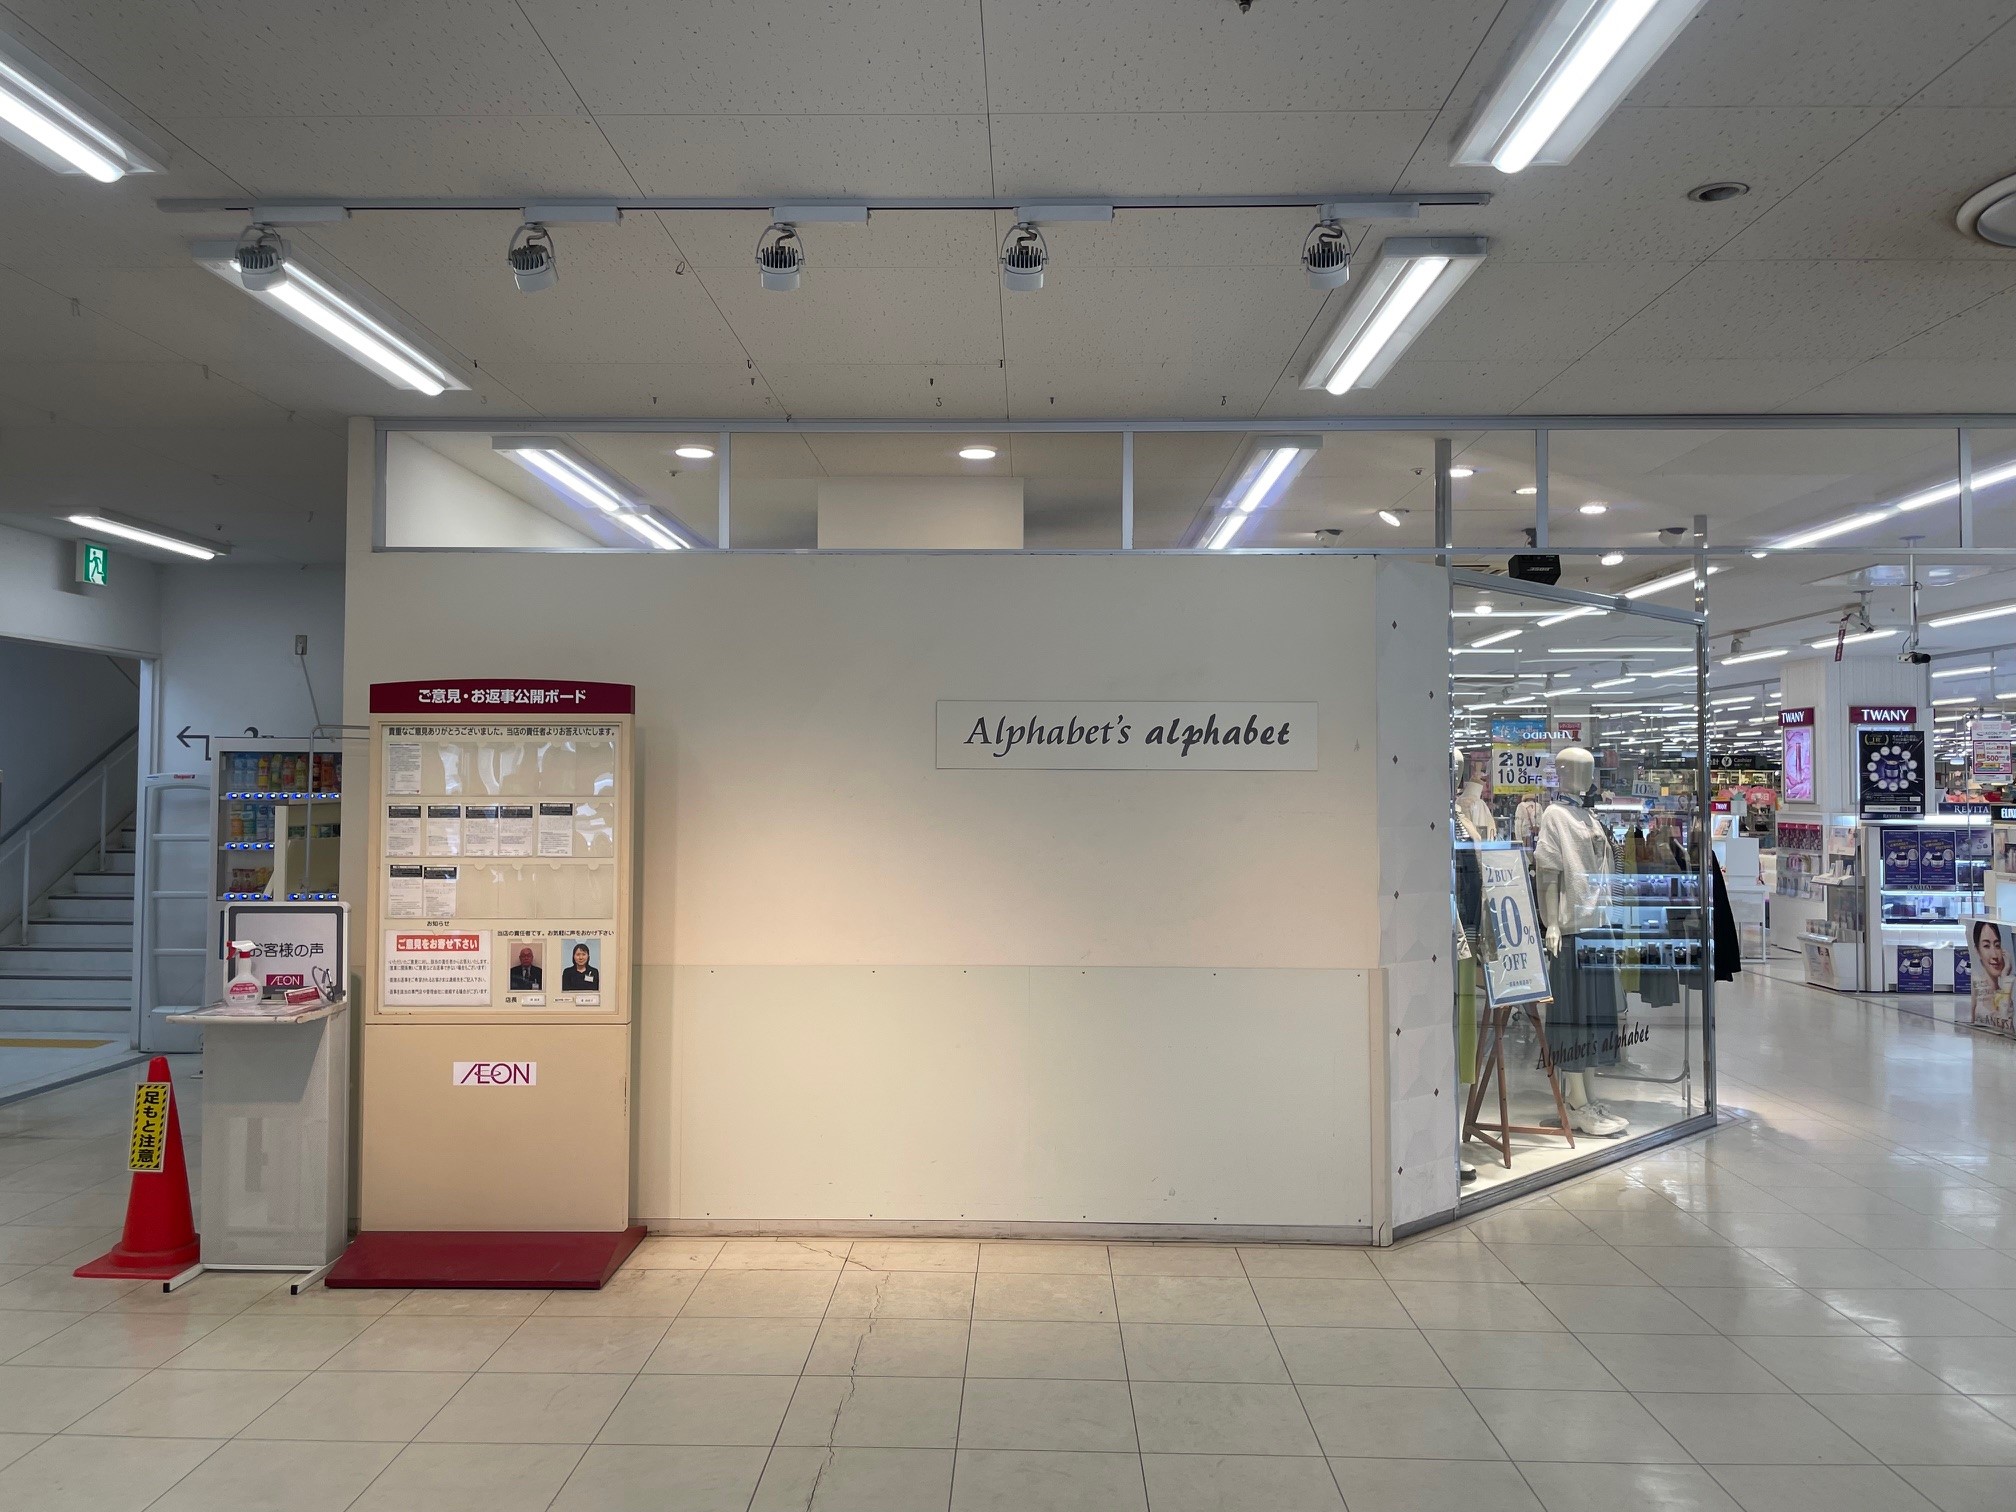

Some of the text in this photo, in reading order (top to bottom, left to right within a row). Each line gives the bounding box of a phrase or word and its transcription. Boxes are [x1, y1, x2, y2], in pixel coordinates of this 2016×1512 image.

[418, 688, 587, 704] ご意見・お返事公開ボード
[1781, 711, 1804, 724] TWANY
[1861, 709, 1909, 721] TWANY
[963, 713, 1291, 758] Alphabet's alphabet
[1516, 752, 1542, 768] Buy
[1518, 775, 1543, 784] OFF
[397, 938, 478, 950] ご意見をお寄せ下さい
[1502, 952, 1528, 972] OFF
[1536, 1021, 1650, 1078] Alphabet's alphabet
[137, 1090, 160, 1163] 足もと注意
